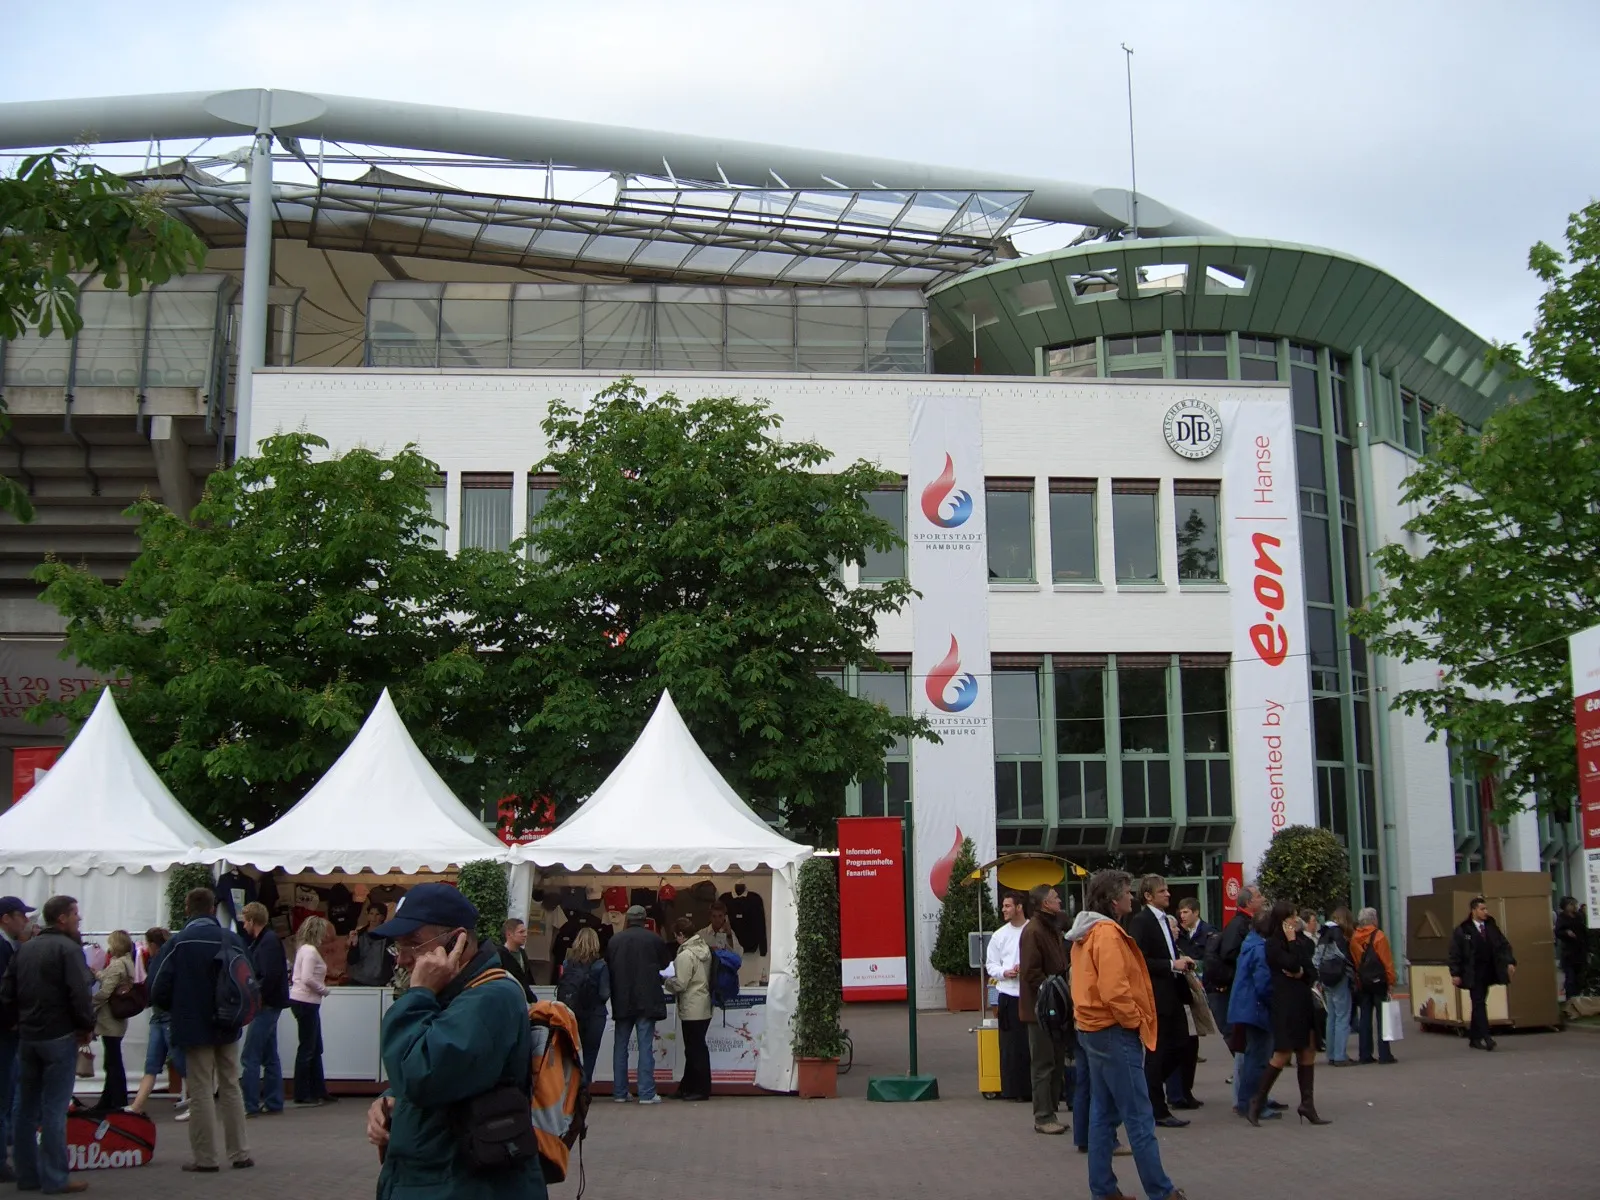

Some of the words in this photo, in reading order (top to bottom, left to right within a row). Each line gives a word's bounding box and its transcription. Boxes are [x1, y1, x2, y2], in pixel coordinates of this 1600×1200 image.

[1164, 401, 1186, 450] DEUTSCHER
[1189, 400, 1220, 424] TENNIS
[1208, 427, 1221, 451] BUND
[1176, 414, 1211, 445] DTB
[1254, 435, 1274, 503] Hanse
[19, 677, 50, 690] 20
[1262, 699, 1285, 726] by
[1263, 735, 1287, 836] resented
[846, 858, 894, 867] Programmhefte
